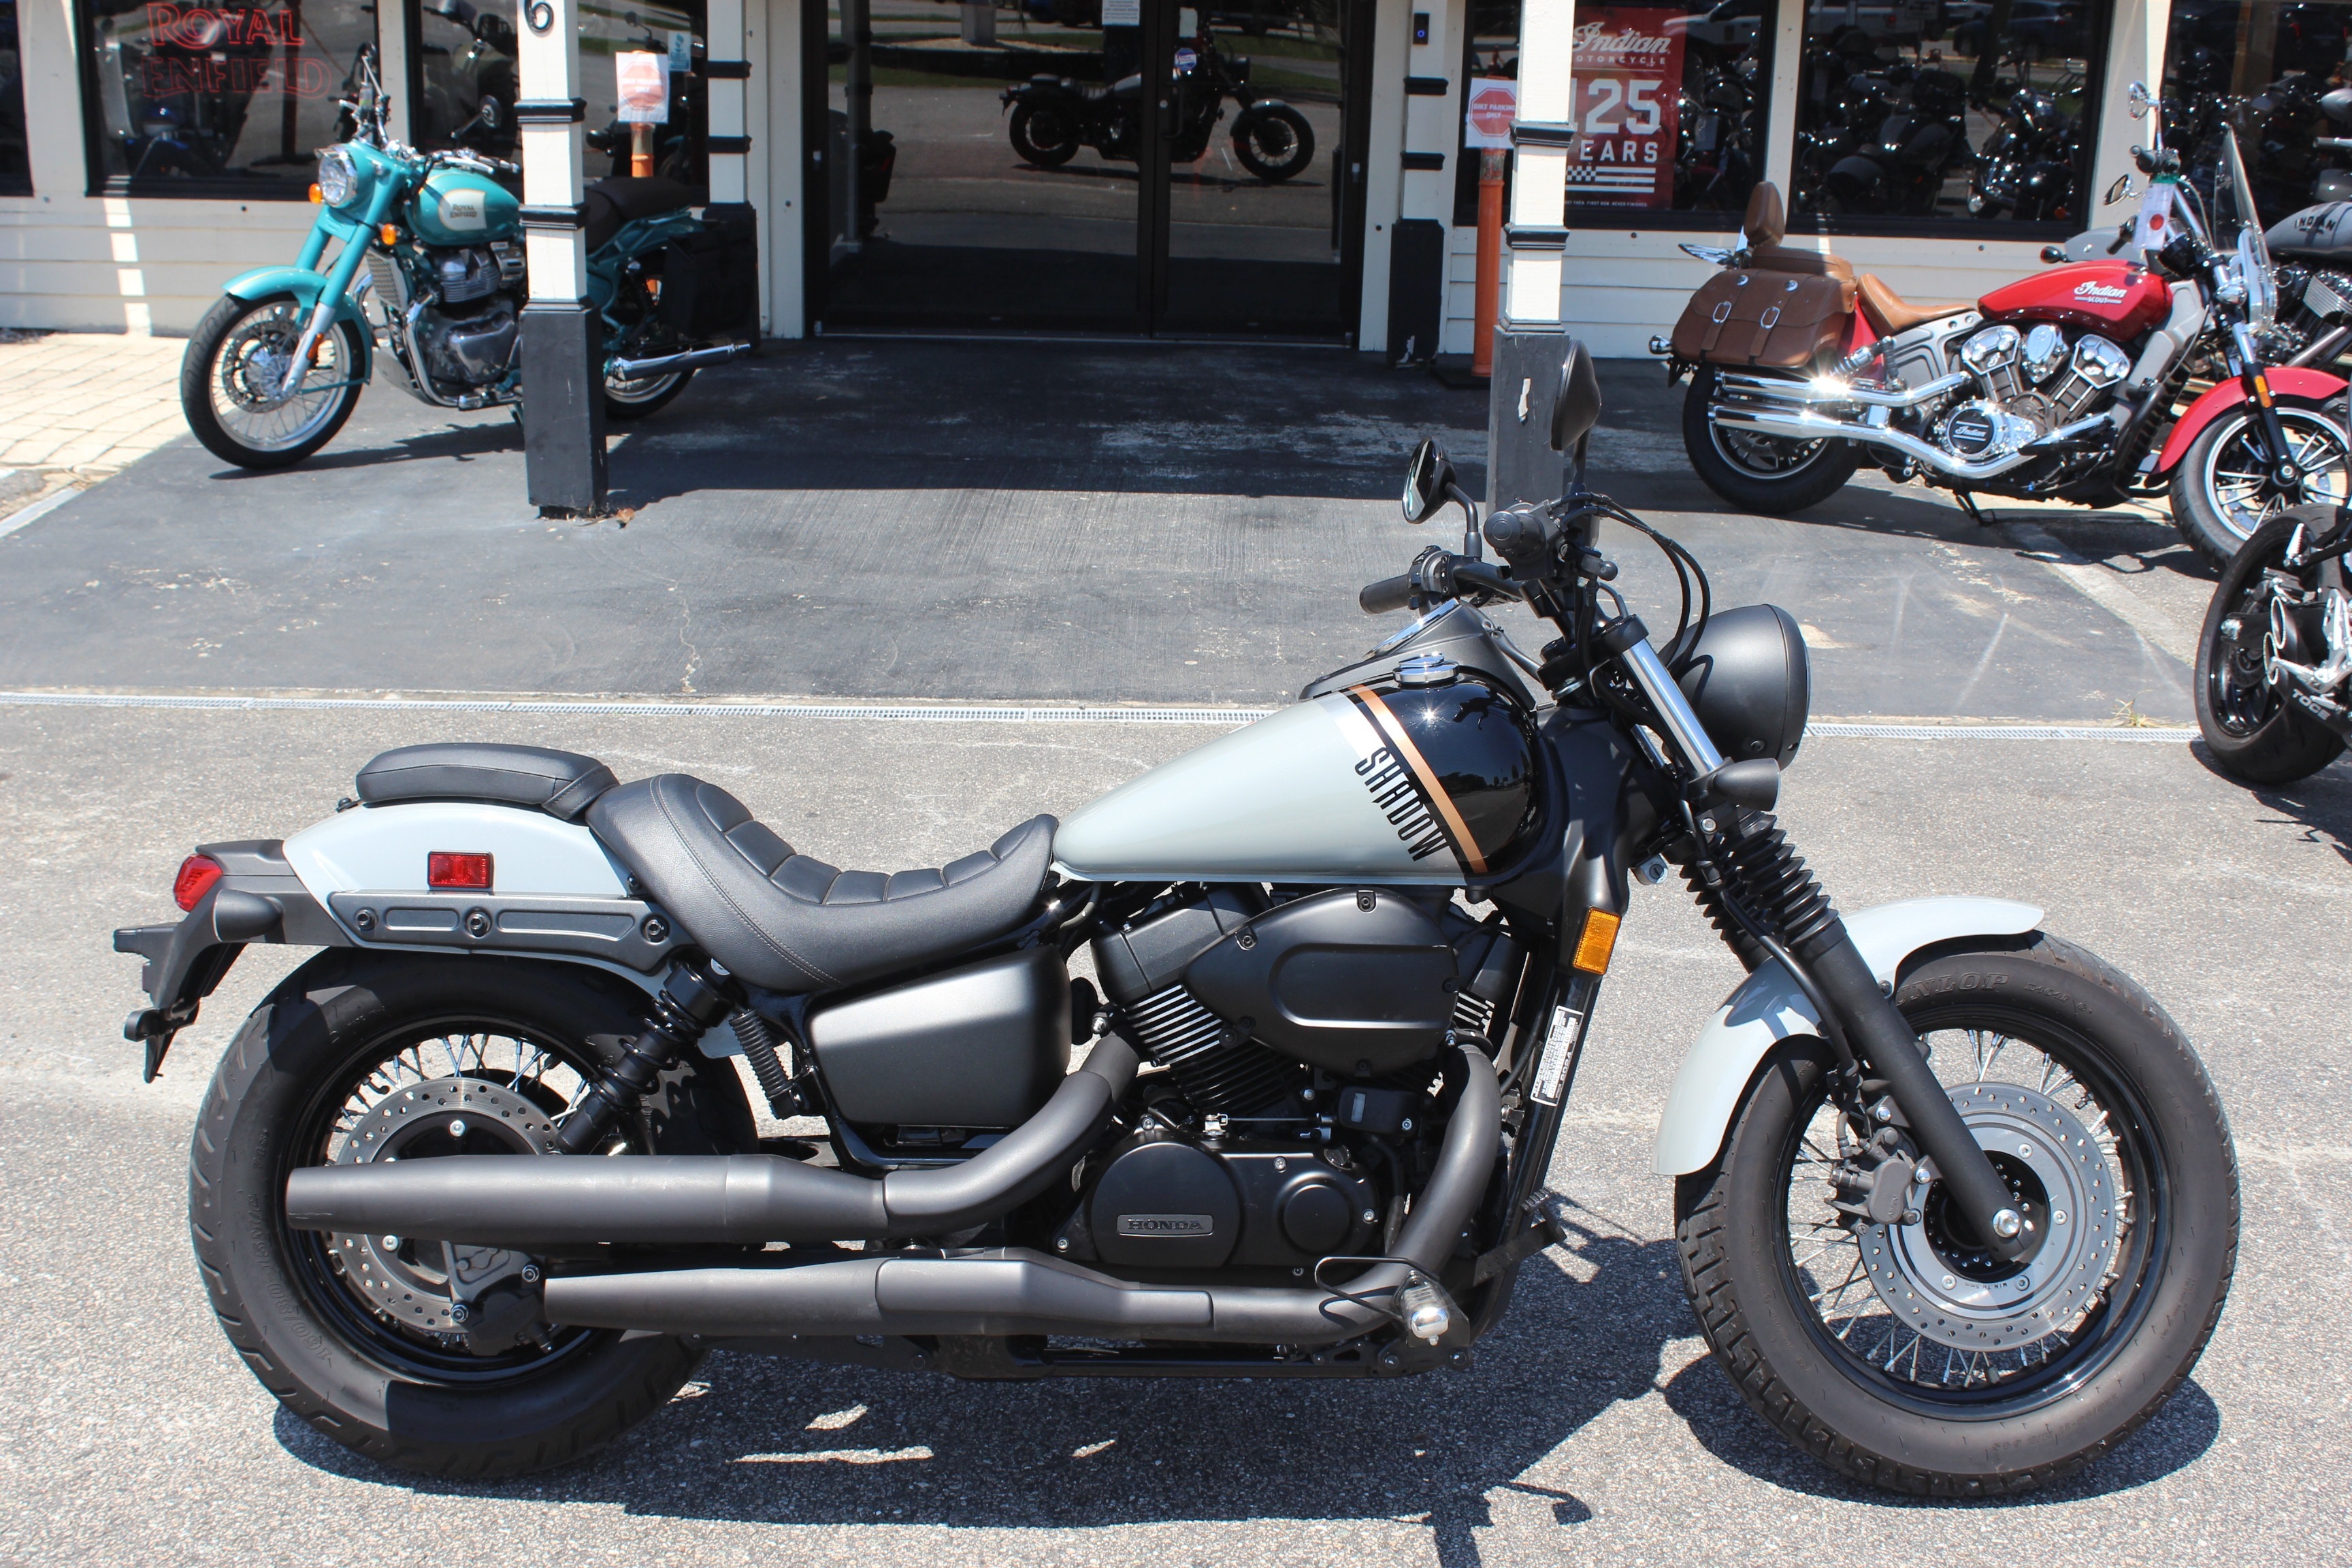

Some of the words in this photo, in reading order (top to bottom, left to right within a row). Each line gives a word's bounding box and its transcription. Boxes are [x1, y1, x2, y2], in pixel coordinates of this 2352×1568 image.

[147, 3, 305, 49] ROYAL
[1572, 22, 1672, 54] Indian
[1576, 55, 1665, 65] OTORCYCLE
[141, 57, 332, 99] ENFIELD
[1490, 103, 1516, 112] PARKING
[1580, 139, 1659, 163] EARS
[450, 210, 478, 218] ENFIELD
[453, 203, 474, 212] ROYAL
[2074, 280, 2127, 298] Indian
[2087, 295, 2108, 304] SCOUT
[1955, 425, 1987, 438] Indian
[2292, 688, 2332, 721] TOCE
[1354, 747, 1450, 862] SHADOW
[1895, 972, 2008, 1007] UNLOP
[1561, 1051, 1571, 1081] 2024
[1128, 1219, 1204, 1230] HONDA
